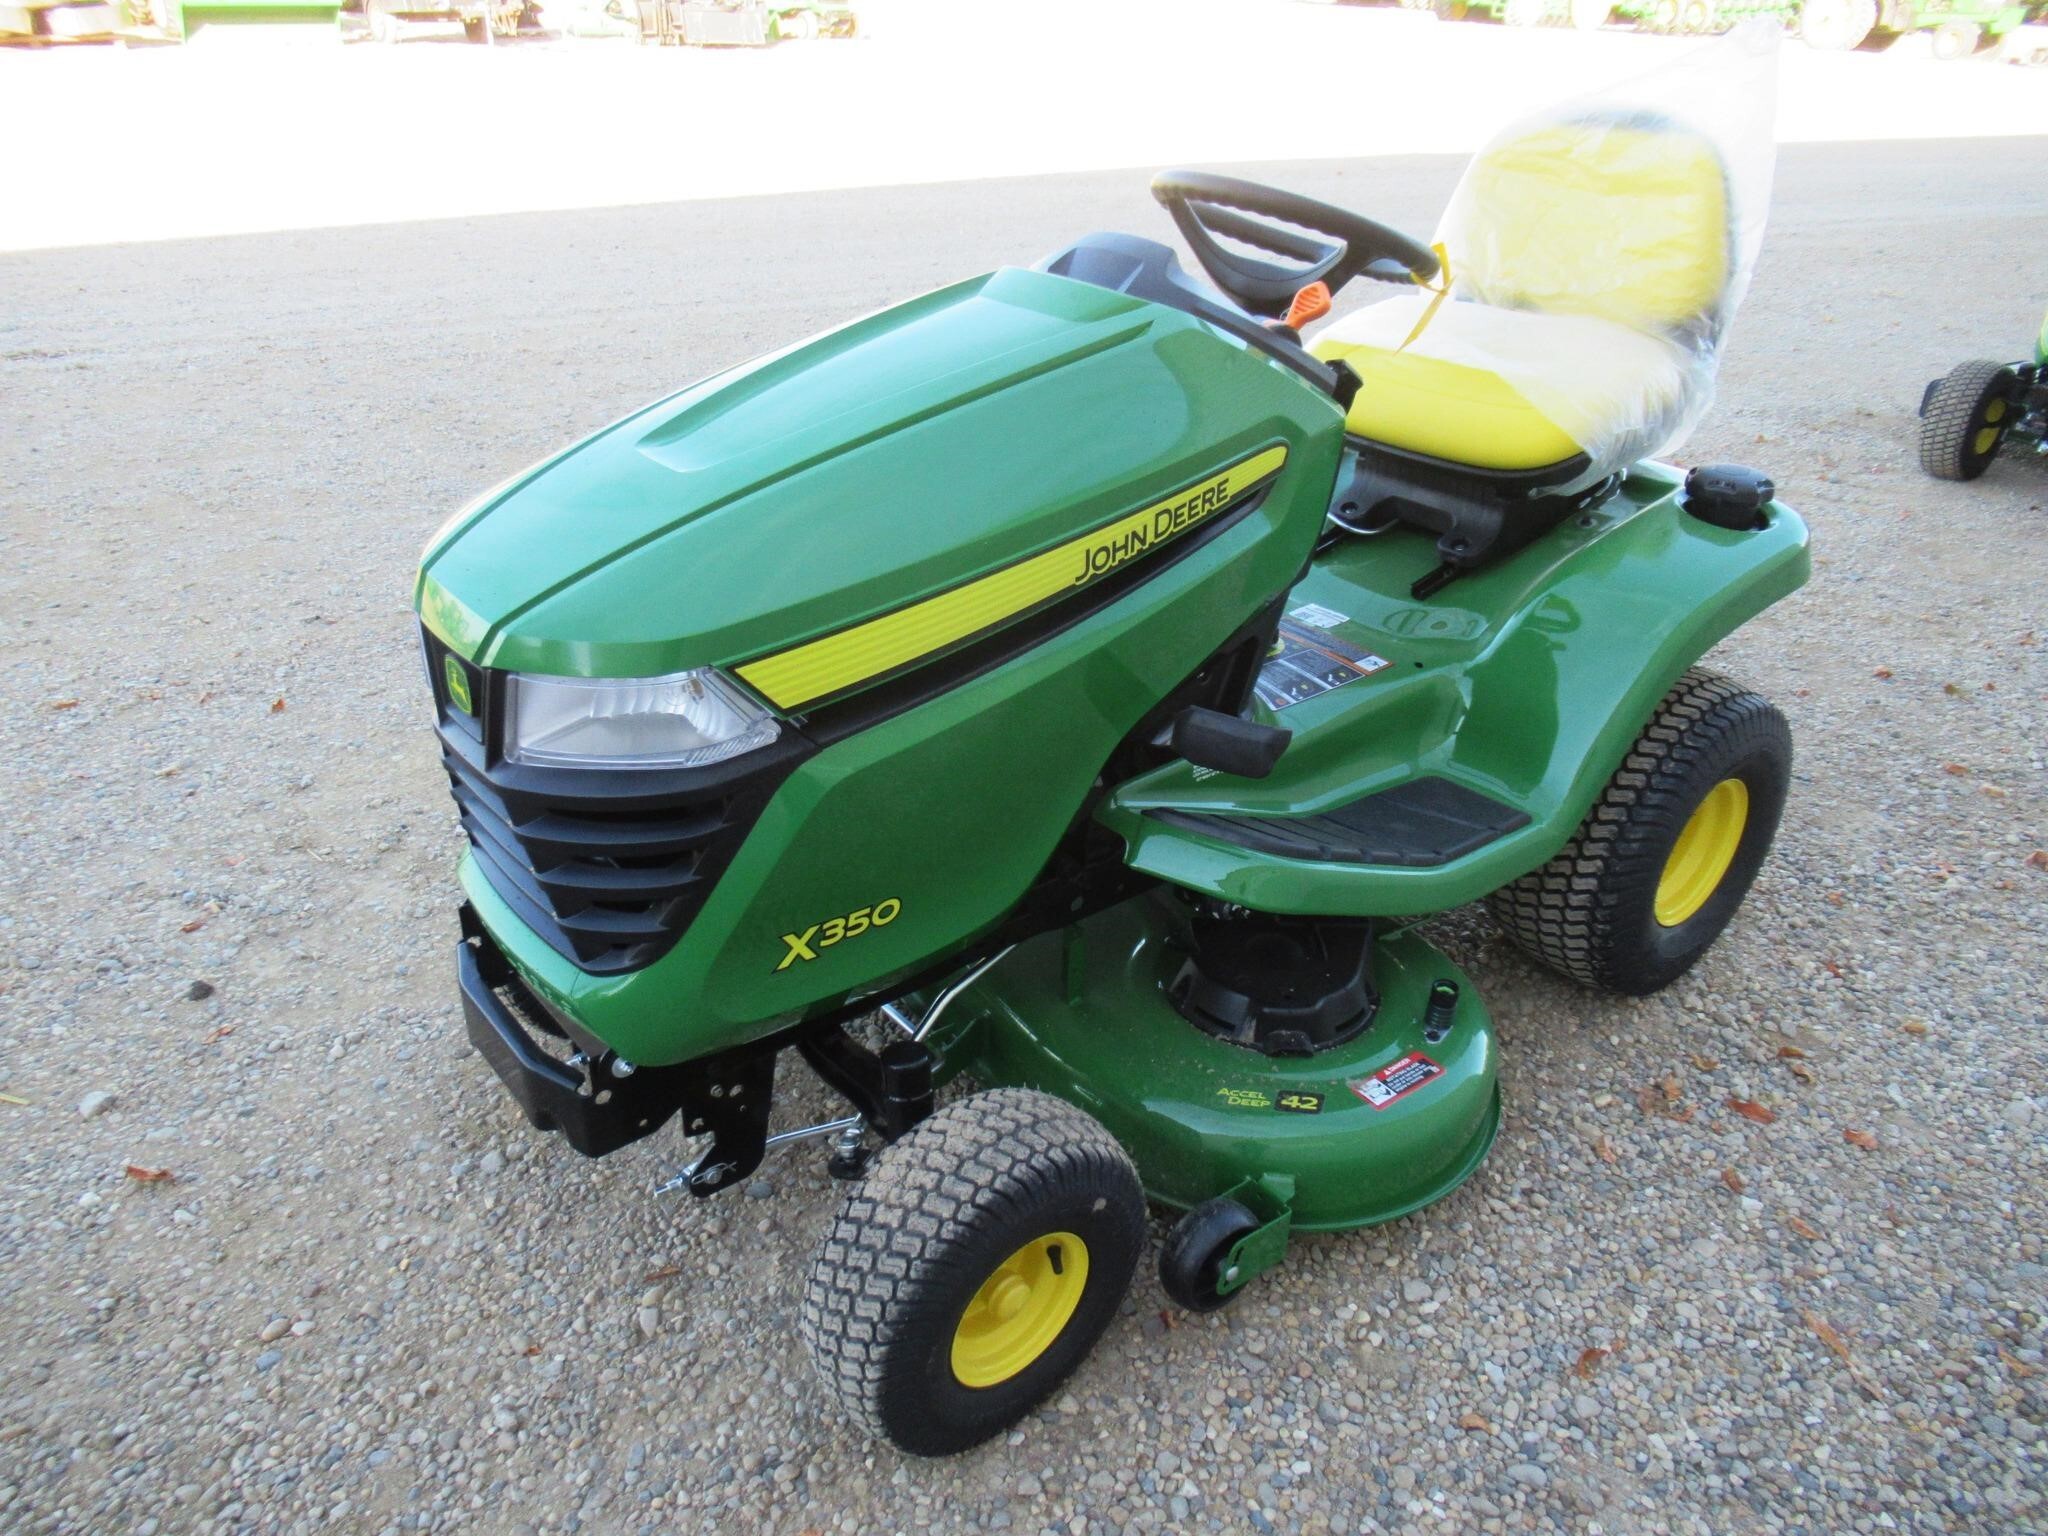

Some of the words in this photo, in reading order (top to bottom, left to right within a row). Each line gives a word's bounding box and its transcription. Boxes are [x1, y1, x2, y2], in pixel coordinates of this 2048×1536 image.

[1075, 523, 1148, 583] JOHN
[1154, 478, 1230, 541] DEERE
[773, 897, 902, 972] X350
[1216, 1087, 1267, 1100] ACCEL
[1227, 1097, 1271, 1108] DEEP
[1280, 1095, 1319, 1110] 42
